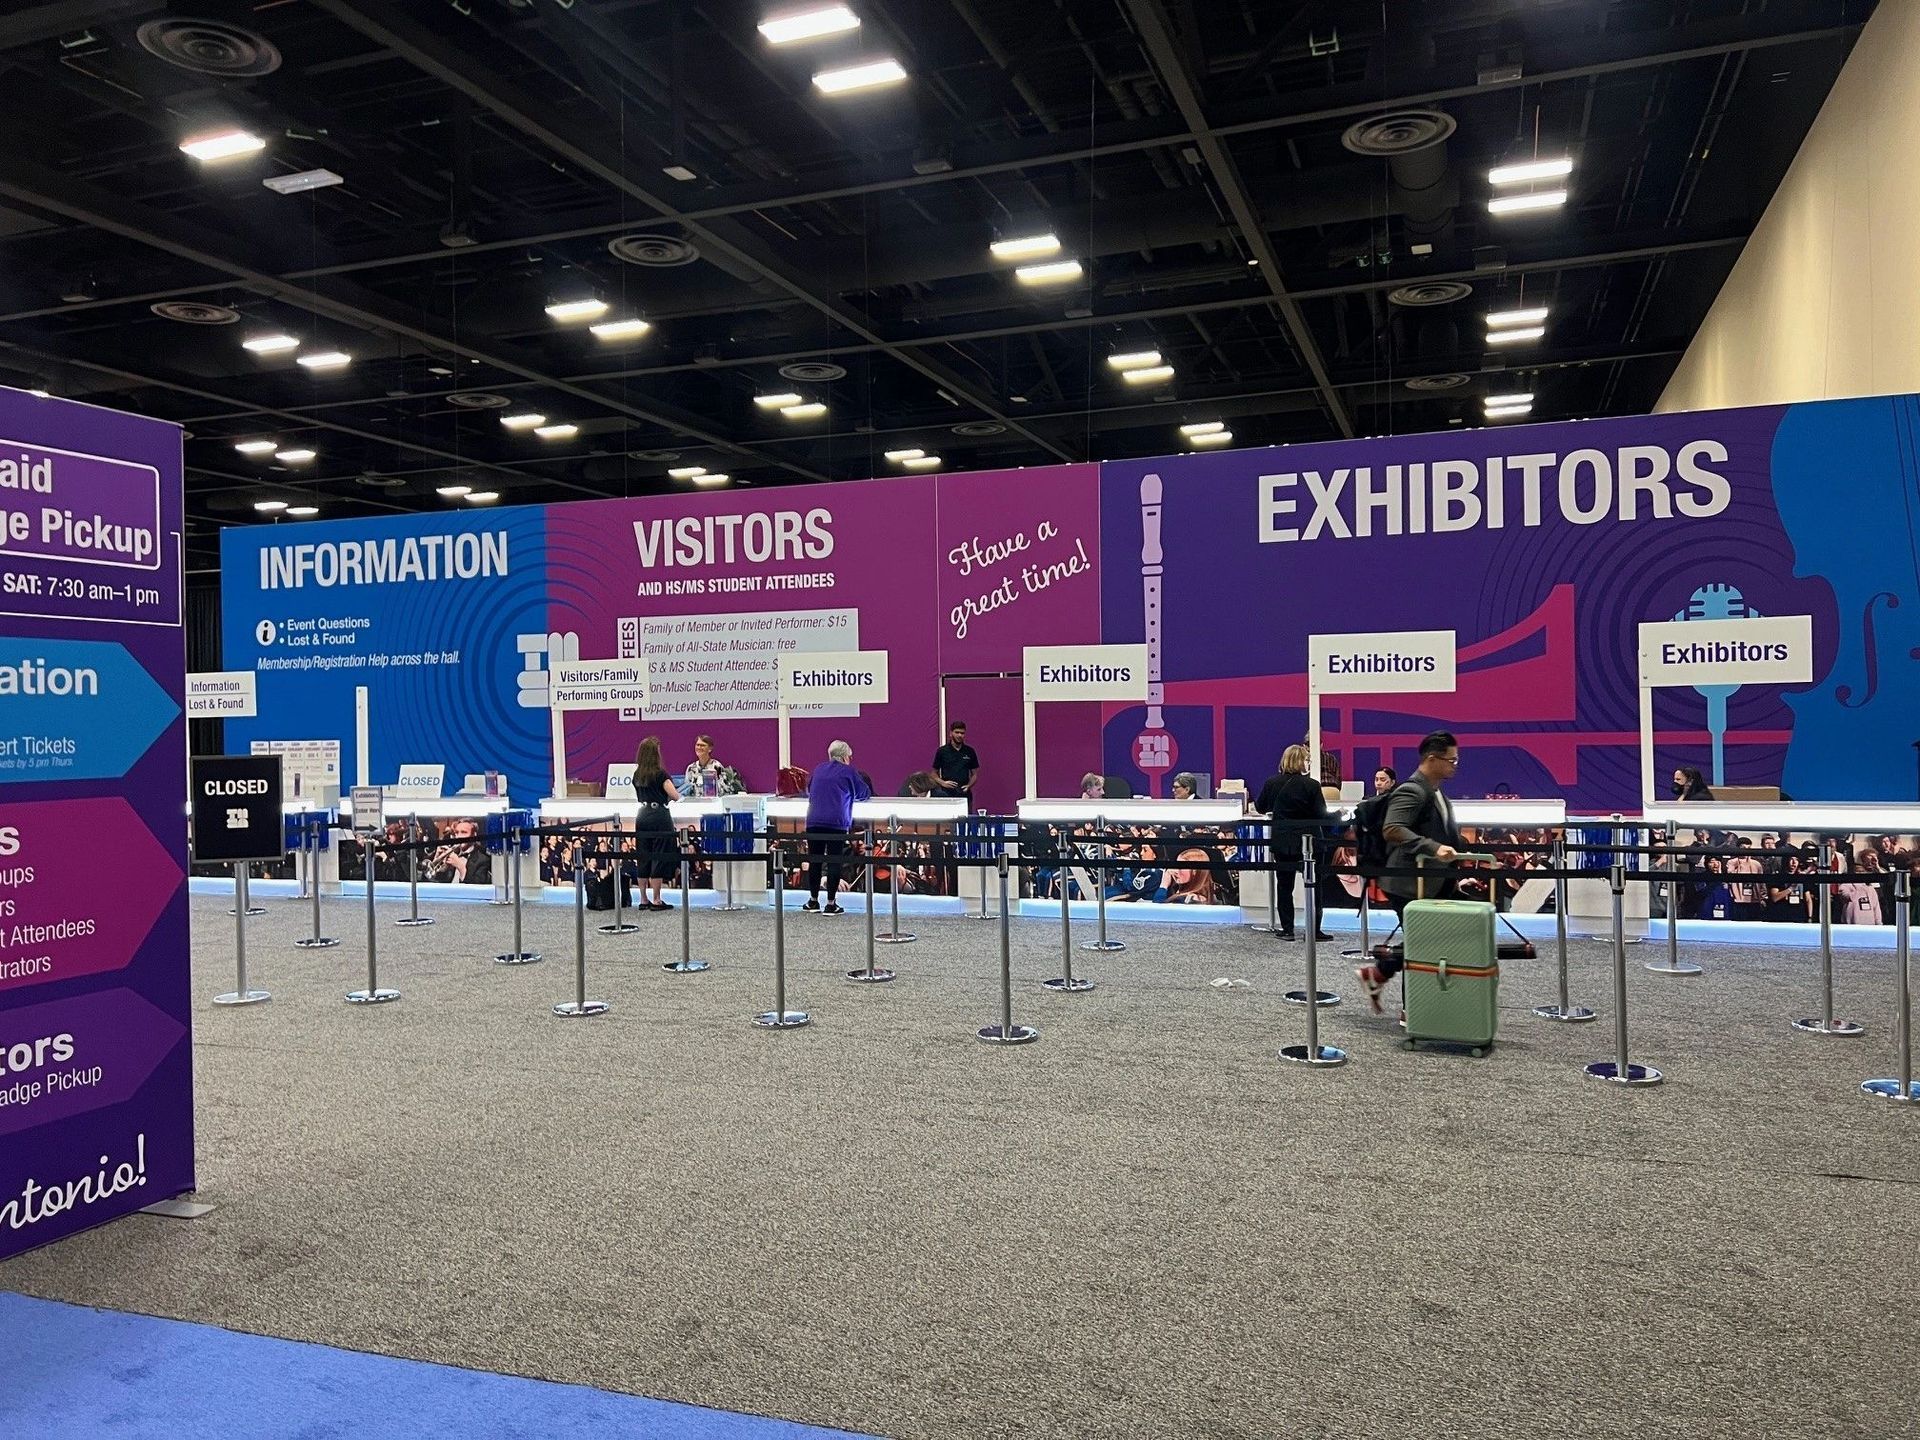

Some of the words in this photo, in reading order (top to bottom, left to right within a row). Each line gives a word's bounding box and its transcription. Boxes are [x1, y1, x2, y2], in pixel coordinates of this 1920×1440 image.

[1257, 439, 1732, 545] EXHIBITORS
[41, 508, 152, 561] Pickup
[633, 508, 835, 568] VISITORS
[948, 532, 1031, 576] Have
[1037, 519, 1058, 541] a
[259, 530, 508, 590] INFORMATION
[3, 572, 42, 595] SAT:
[47, 577, 84, 599] 7:30
[136, 588, 160, 606] pm
[637, 581, 662, 596] AND
[665, 579, 705, 595] HS/MS
[708, 576, 763, 593] STUDENT
[765, 573, 835, 590] ATTENDEES
[950, 576, 1020, 639] great
[1021, 538, 1091, 593] time!
[287, 618, 316, 631] Event
[317, 616, 370, 630] Questions
[643, 622, 674, 636] Family
[675, 621, 685, 633] of
[687, 620, 726, 633] Member
[728, 621, 739, 631] or
[740, 618, 773, 631] Invited
[774, 617, 825, 629] Performer:
[827, 615, 847, 628] $15
[287, 633, 310, 646] Lost
[312, 632, 320, 645] &
[322, 632, 355, 645] Found
[622, 621, 635, 659] FEES
[643, 642, 674, 655] Family
[675, 641, 686, 653] of
[686, 640, 727, 653] All-State
[729, 639, 774, 651] Musician:
[777, 638, 797, 649] free
[257, 653, 366, 671] Membership/Registration
[367, 653, 389, 669] Help
[390, 654, 421, 666] across
[423, 651, 439, 665] the
[440, 650, 460, 664] hall.
[1661, 639, 1788, 666] Exhibitors
[659, 661, 666, 673] &
[669, 661, 685, 673] MS
[687, 660, 723, 673] Student
[724, 658, 770, 671] Attendee:
[1327, 651, 1436, 675] Exhibitors
[560, 668, 639, 683] Visitors/Family
[792, 669, 873, 687] Exhibitors
[1039, 665, 1131, 683] Exhibitors
[191, 681, 240, 692] Information
[557, 689, 608, 702] Performing
[610, 688, 644, 701] Groups
[649, 681, 692, 693] on-Music
[695, 680, 729, 692] Teacher
[730, 679, 773, 691] Attendee:
[188, 699, 207, 710] Lost
[208, 698, 215, 709] &
[217, 697, 244, 709] Found
[702, 699, 734, 712] School
[22, 736, 76, 755] Tickets
[204, 779, 269, 796] CLOSED
[400, 776, 440, 786] CLOSED
[609, 776, 632, 786] CLO
[0, 866, 34, 888] ups
[10, 918, 96, 947] Attendees
[47, 1066, 102, 1095] Pickup
